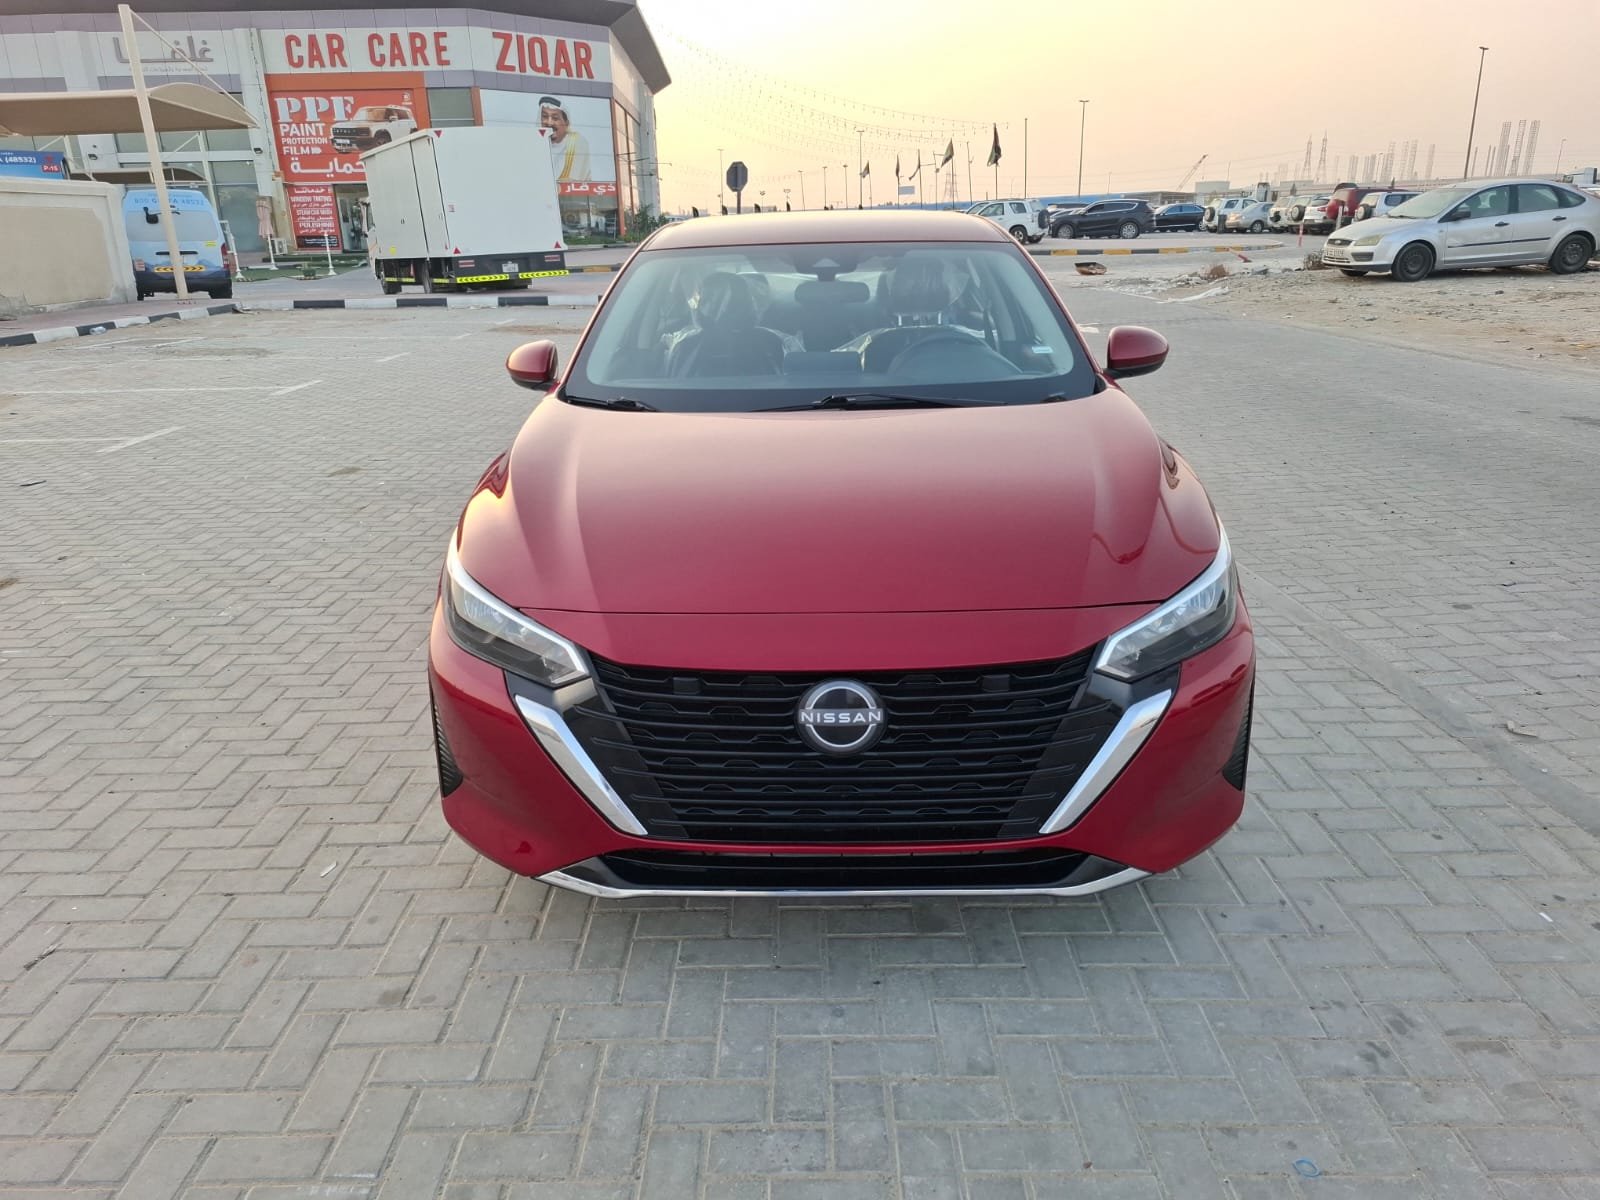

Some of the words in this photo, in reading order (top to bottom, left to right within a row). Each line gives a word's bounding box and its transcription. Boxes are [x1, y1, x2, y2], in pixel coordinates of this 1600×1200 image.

[284, 33, 348, 68] CAR
[367, 31, 450, 67] CARE
[492, 31, 594, 79] ZIQAR
[274, 96, 354, 122] PPF
[279, 123, 325, 137] PAINT
[281, 137, 327, 145] PROTECTION
[282, 146, 310, 155] FILM
[290, 157, 367, 178] حماية
[593, 183, 616, 195] ذي
[801, 711, 881, 723] NISSAN
